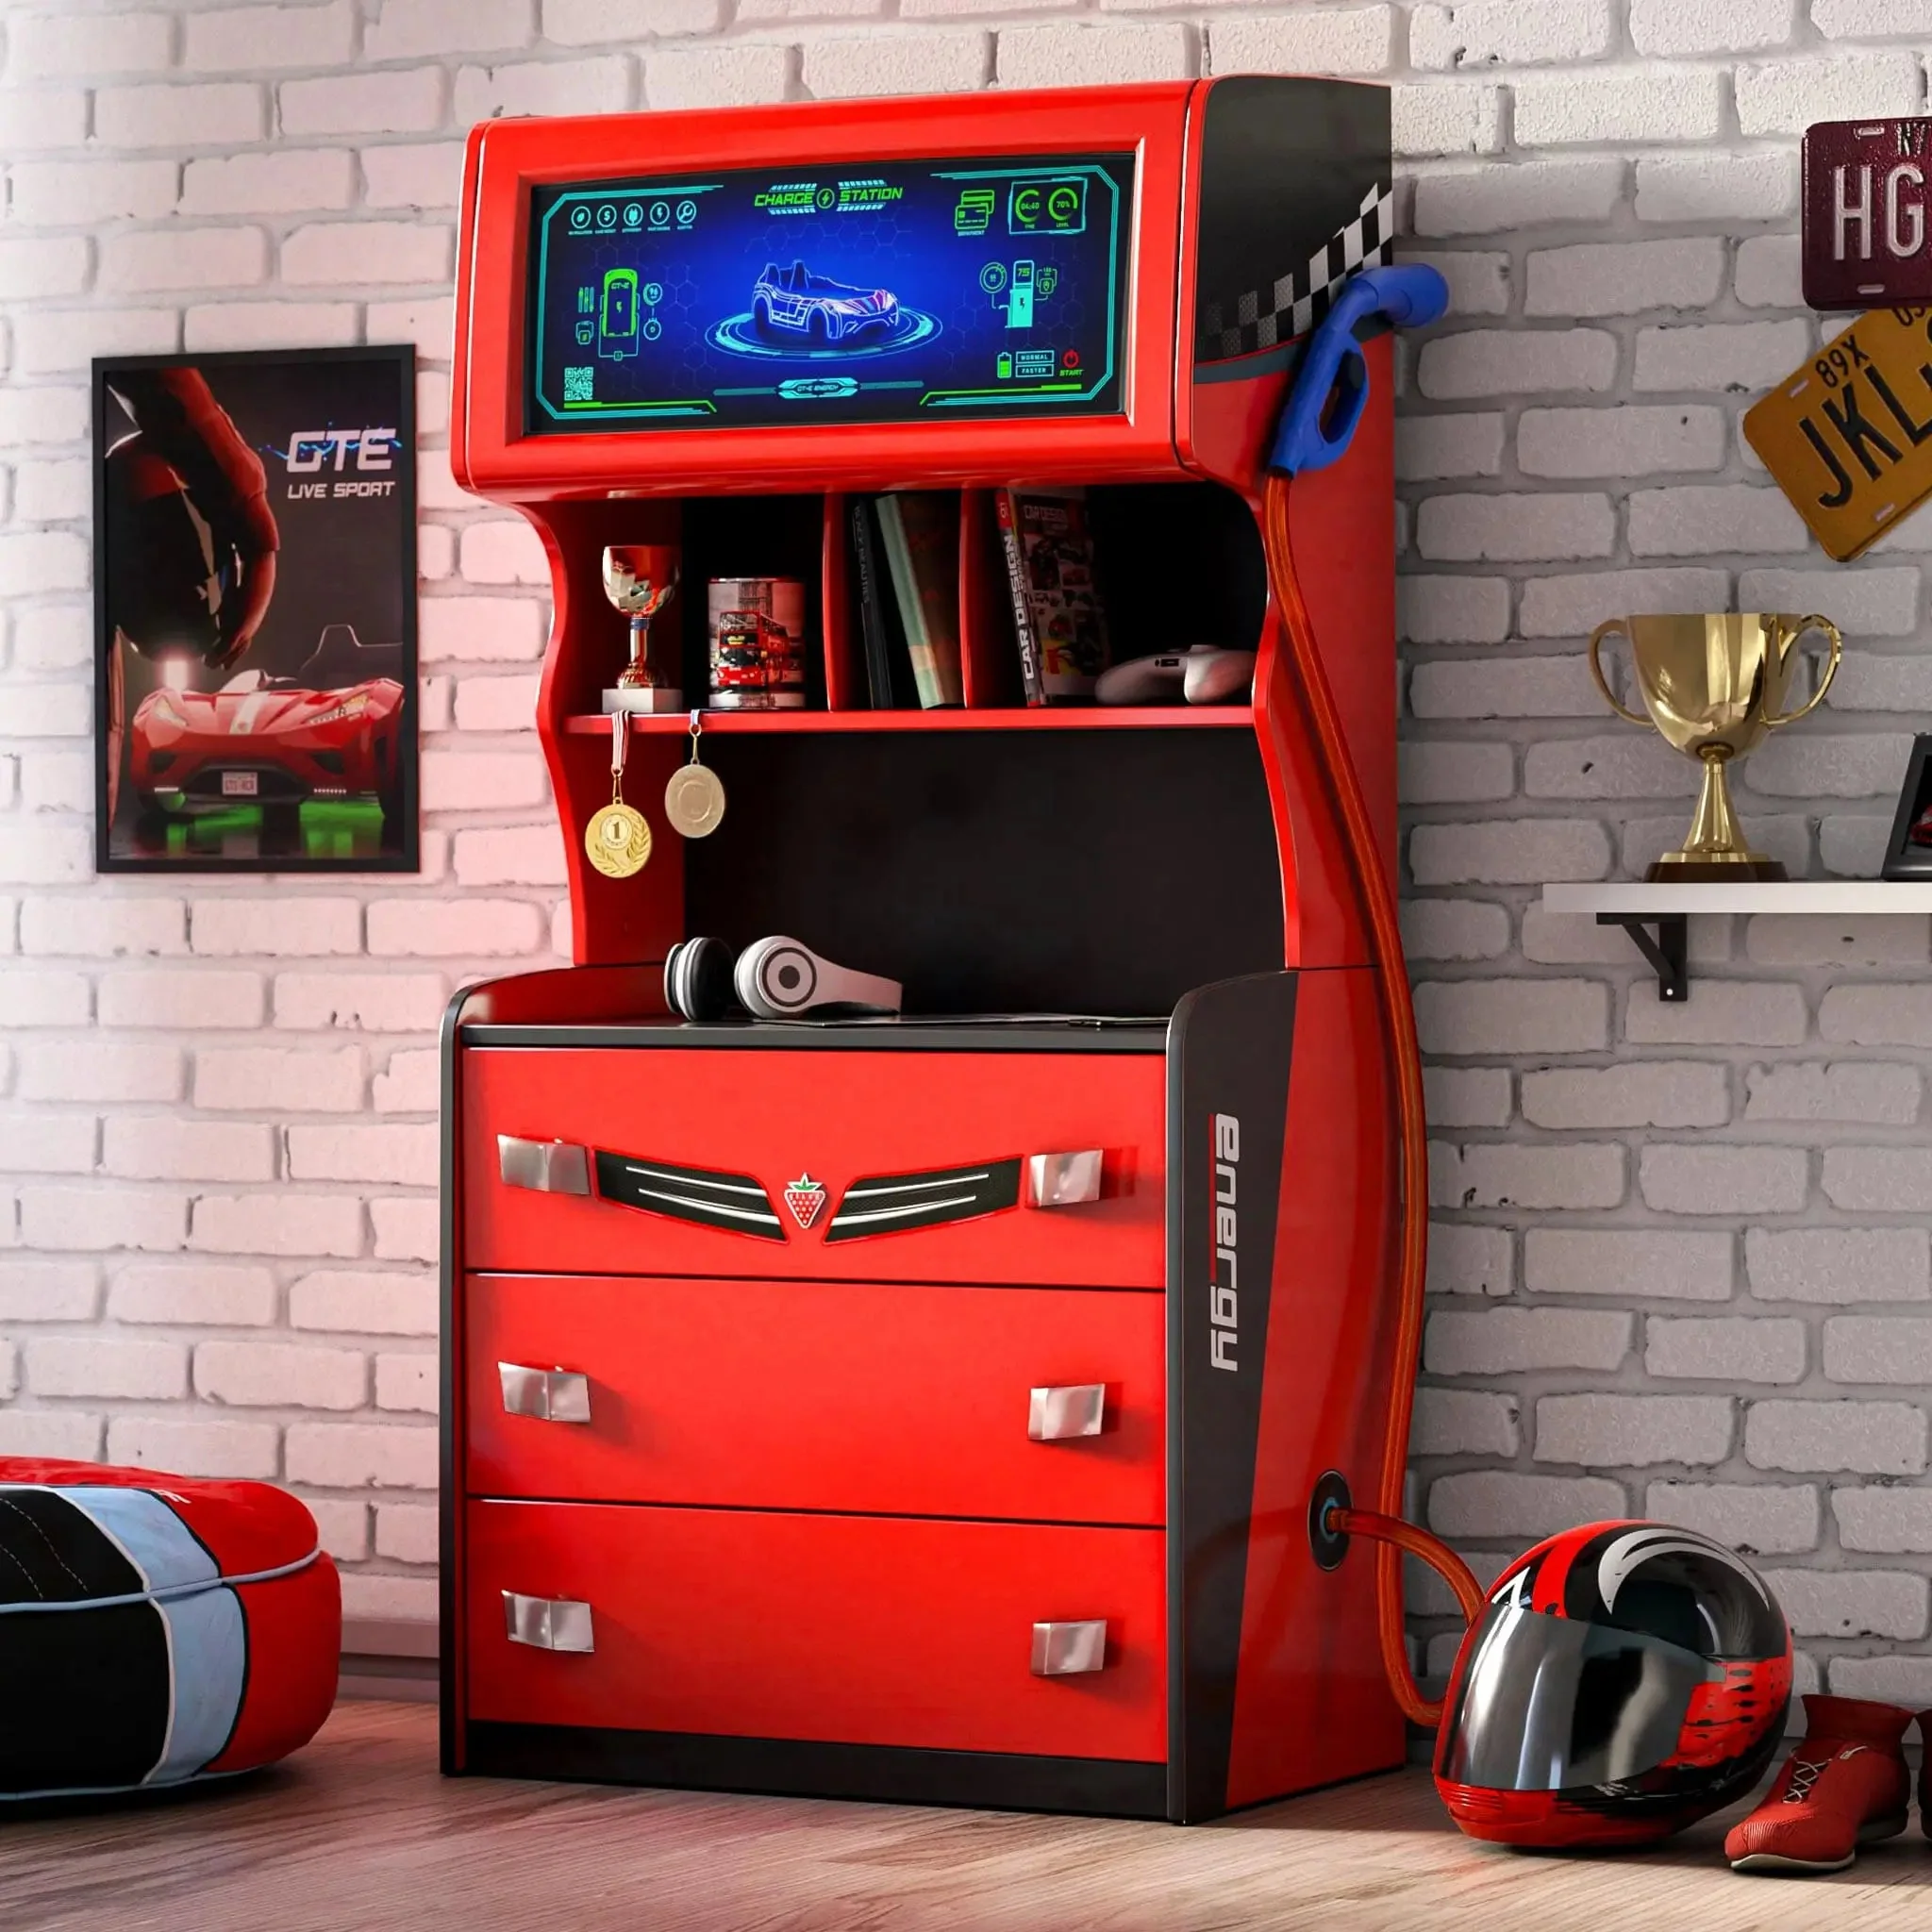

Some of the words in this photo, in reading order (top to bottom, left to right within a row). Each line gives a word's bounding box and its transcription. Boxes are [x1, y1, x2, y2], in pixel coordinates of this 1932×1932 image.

[754, 192, 815, 207] CHARGE
[840, 187, 903, 202] STATION
[1834, 162, 1924, 259] HG
[1815, 334, 1871, 388] 89X
[287, 428, 396, 473] GTE
[1798, 361, 1932, 508] JKL
[288, 483, 327, 499] LIVE
[333, 481, 395, 498] SPORT
[1004, 534, 1028, 626] DESIGN
[1019, 627, 1035, 680] CAR
[613, 822, 621, 839] 1
[1209, 1112, 1240, 1372] energy
